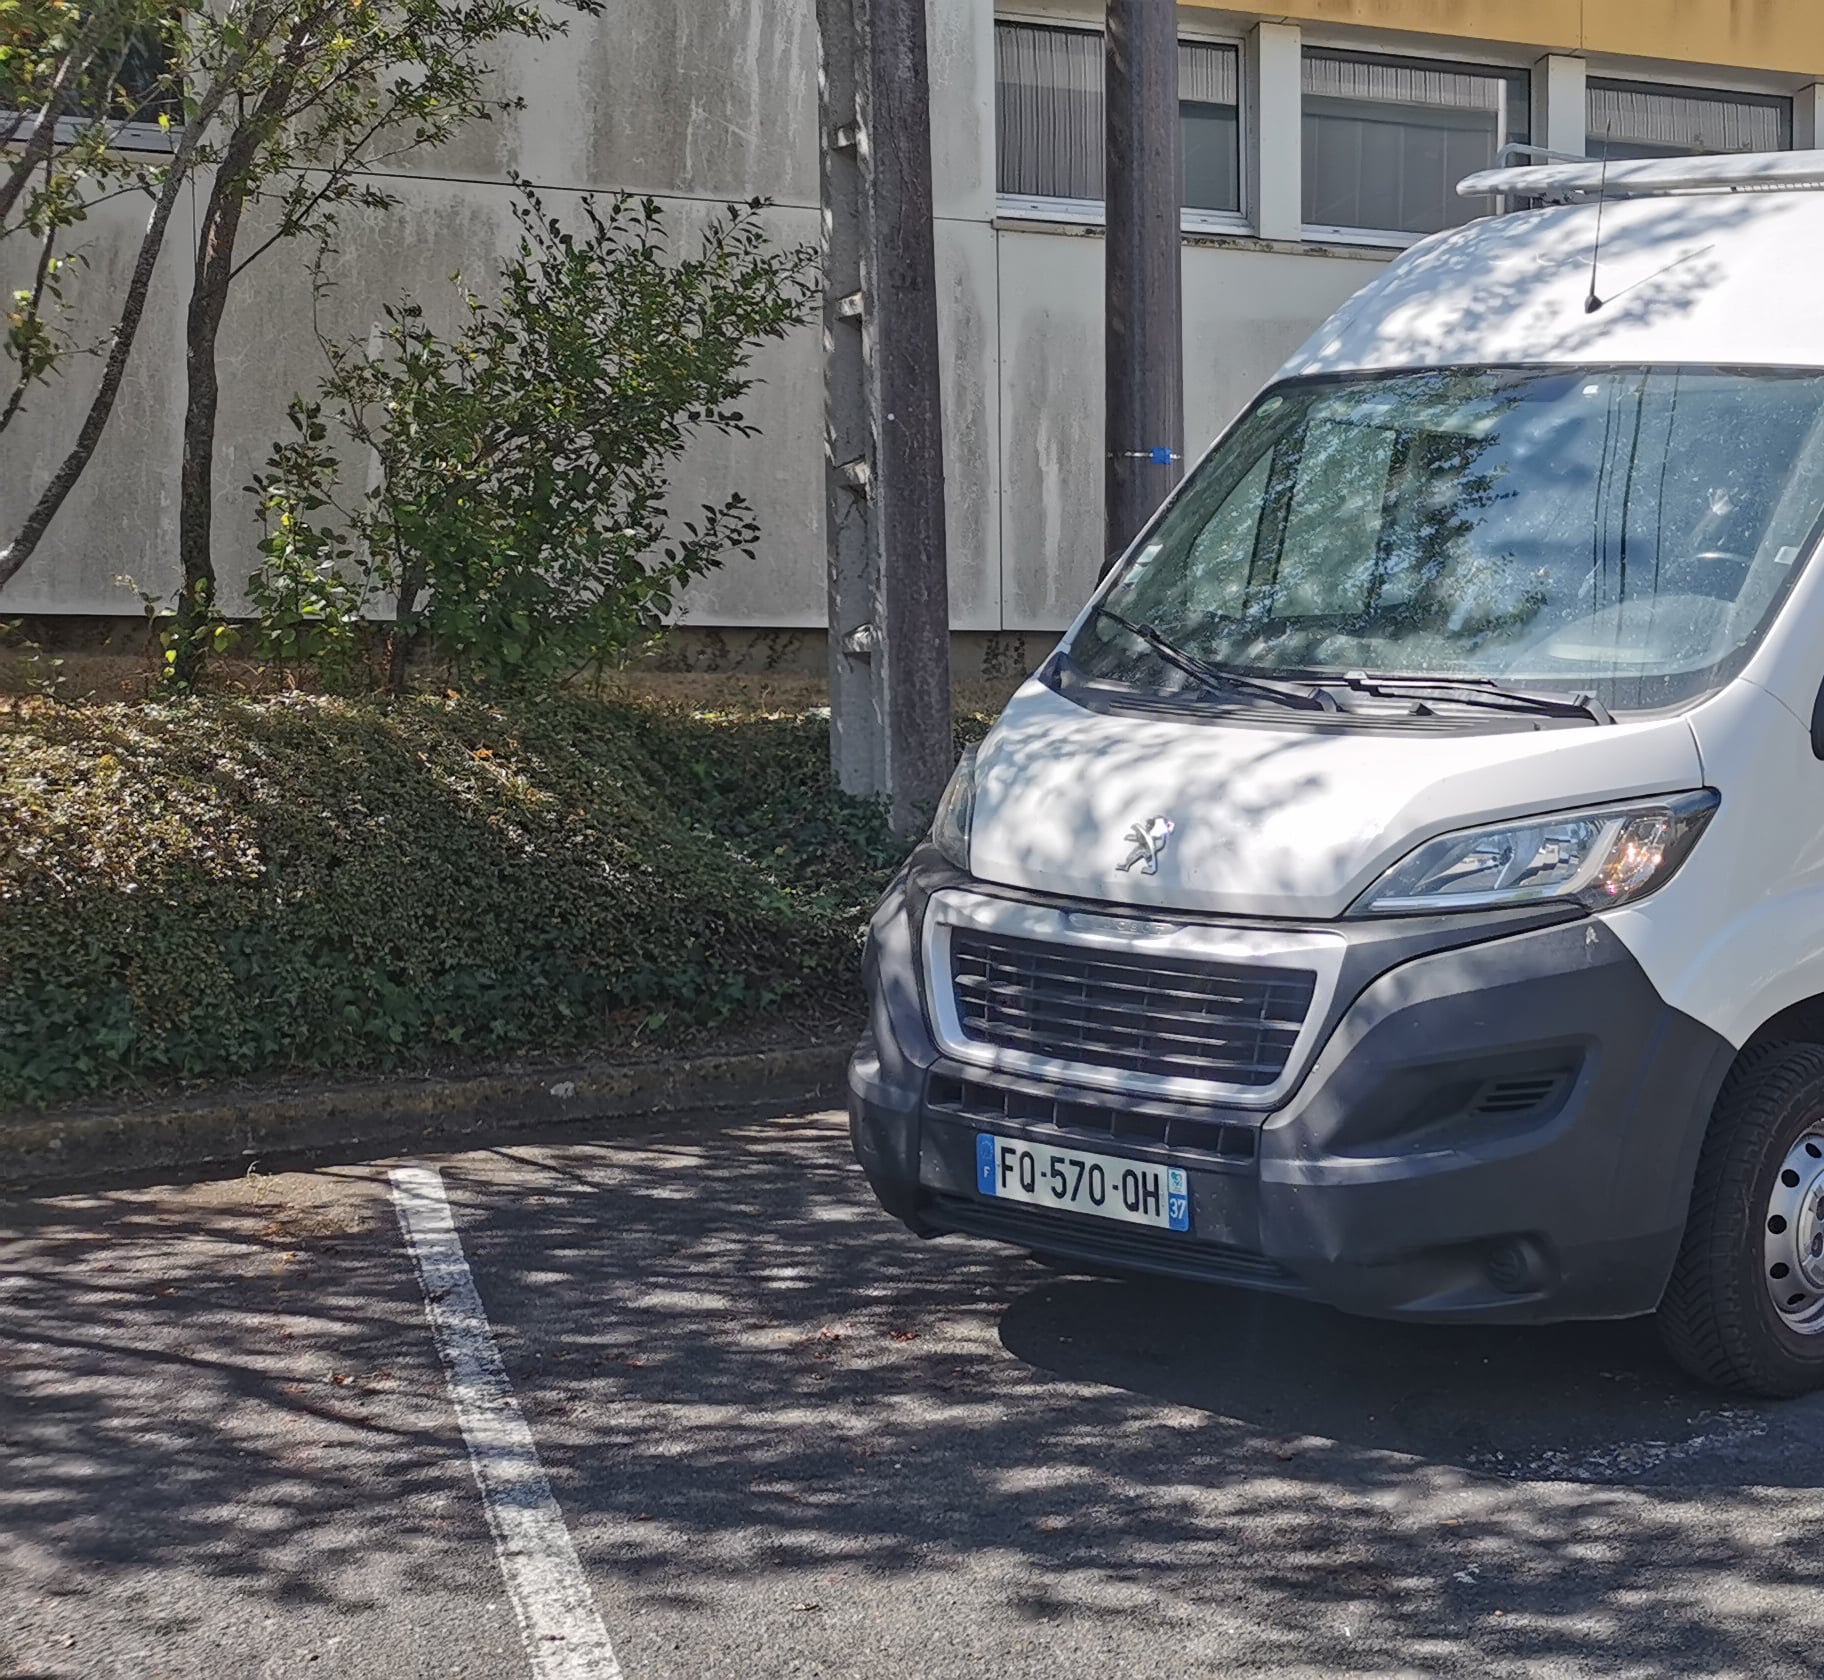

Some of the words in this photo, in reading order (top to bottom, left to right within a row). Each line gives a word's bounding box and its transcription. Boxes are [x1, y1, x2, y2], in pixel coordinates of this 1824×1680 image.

[983, 1167, 990, 1178] F
[1000, 1145, 1161, 1217] FQ-570-QH
[1169, 1198, 1187, 1220] 37
